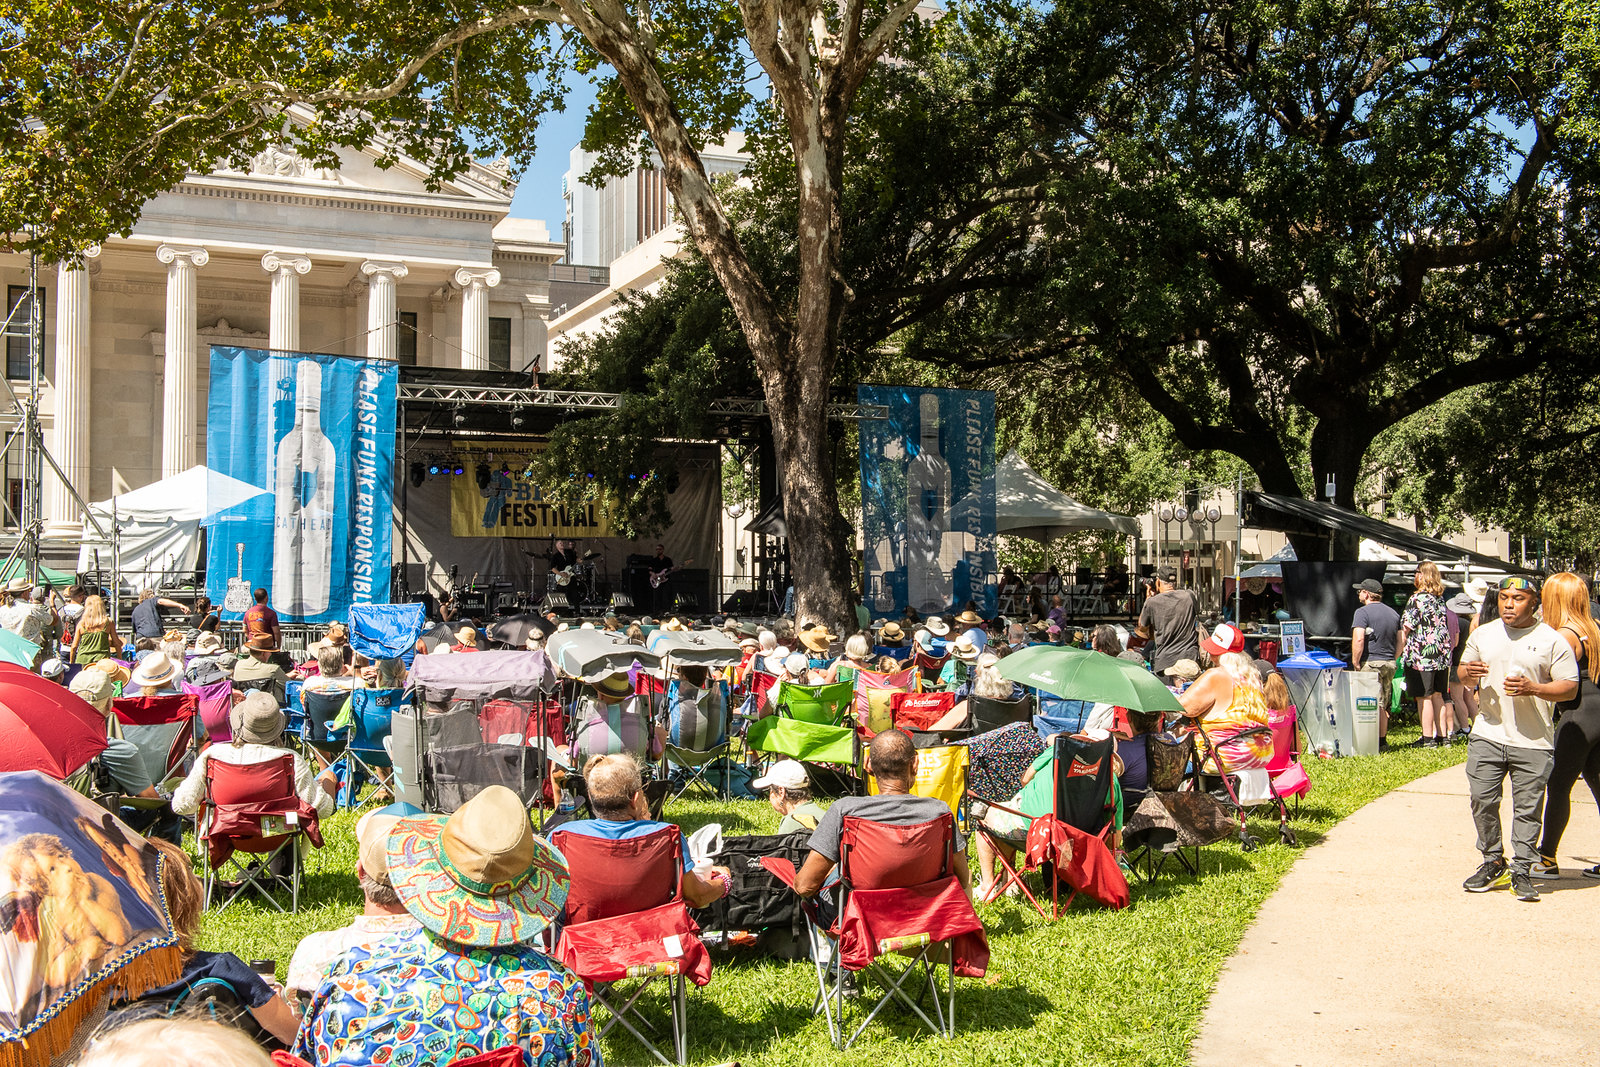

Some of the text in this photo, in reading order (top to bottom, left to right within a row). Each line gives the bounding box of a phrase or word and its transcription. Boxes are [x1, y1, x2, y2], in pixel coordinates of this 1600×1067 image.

[358, 368, 380, 434] PLEASE
[357, 437, 377, 489] FUNK
[501, 503, 599, 527] FESTIVAL
[965, 398, 986, 611] PLEASE FUNK RESNSIBLY
